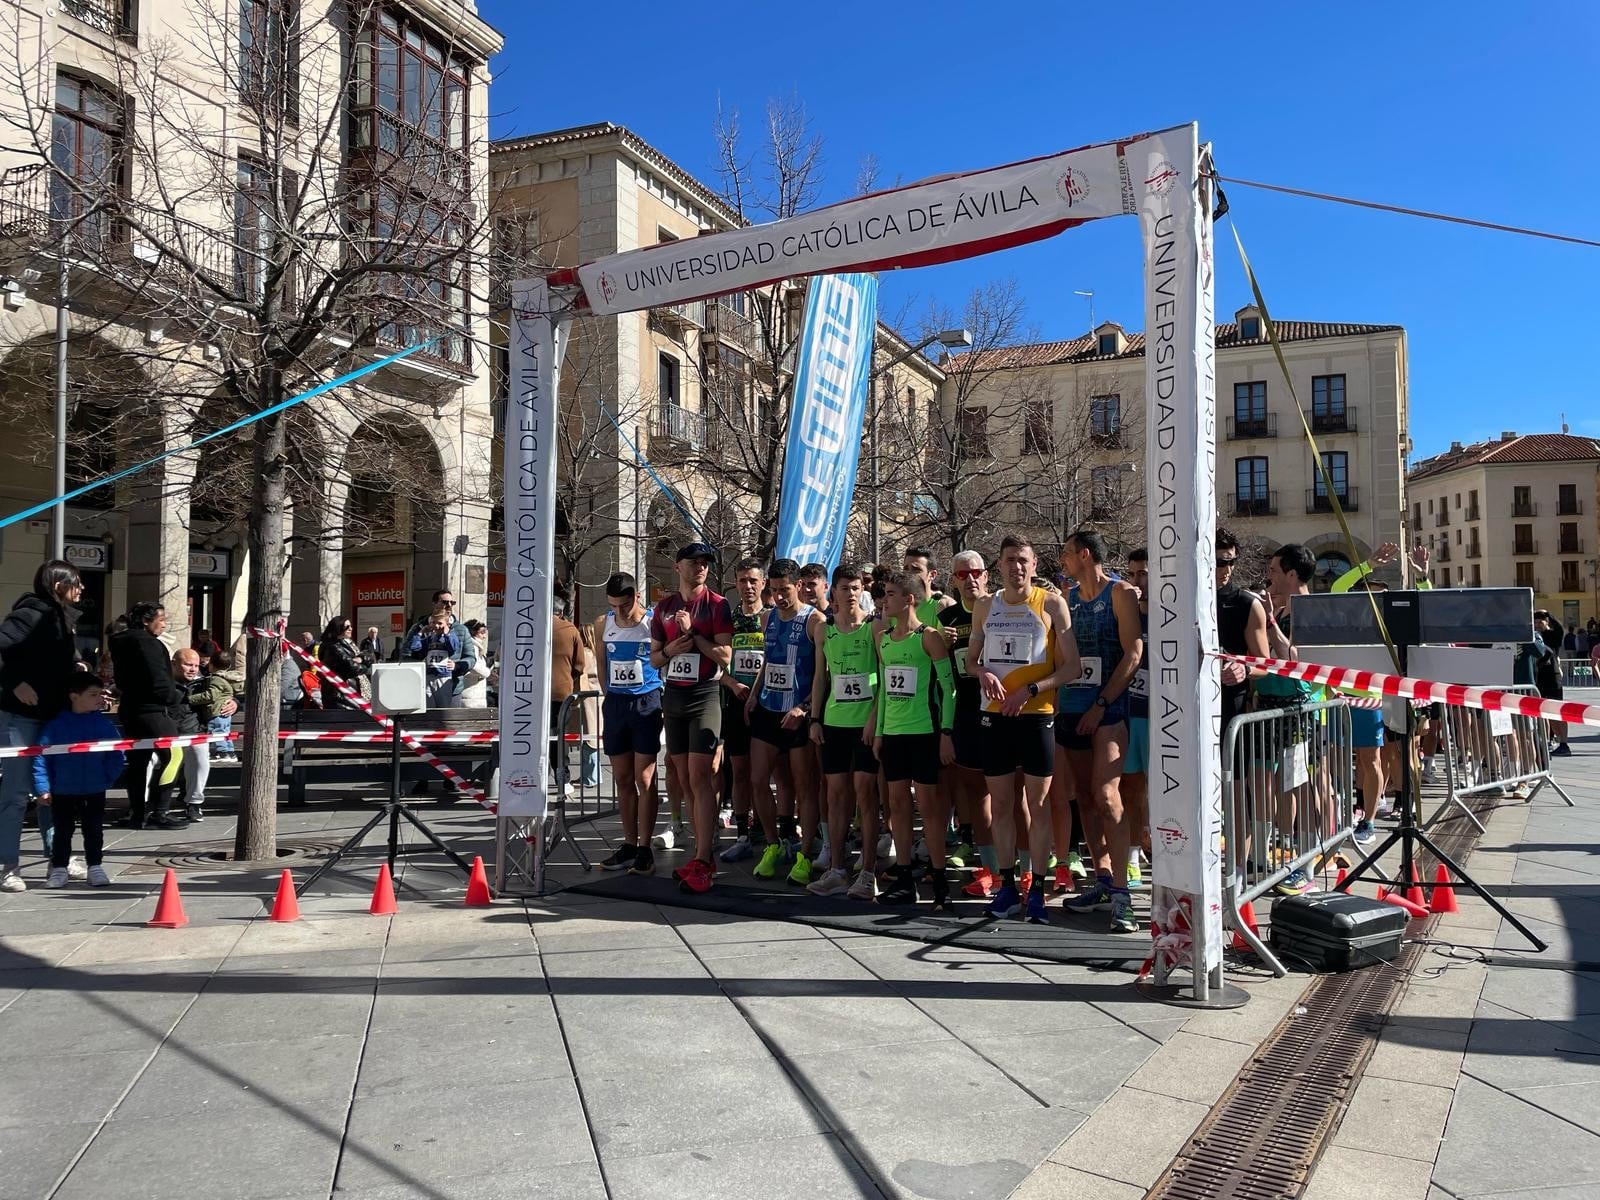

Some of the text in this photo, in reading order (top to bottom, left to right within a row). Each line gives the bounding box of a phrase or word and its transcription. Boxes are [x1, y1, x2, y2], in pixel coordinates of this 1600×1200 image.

[625, 242, 775, 292] UNIVERSIDAD
[781, 214, 901, 258] CATÓLICA
[907, 203, 945, 232] DE
[953, 185, 1039, 223] ÁVILA
[1154, 214, 1176, 450] UNIVERSIDAD
[516, 342, 540, 413] ÁVILA
[519, 419, 538, 452] DE
[514, 459, 537, 578] CATÓLICA
[1158, 461, 1182, 628] CATÓLICA
[357, 589, 405, 601] bankinter
[739, 658, 761, 670] 108
[1004, 642, 1012, 656] 1
[1160, 640, 1179, 685] DE
[513, 585, 535, 756] UNIVERSIDAD
[614, 669, 636, 681] 166
[672, 662, 692, 674] 168
[769, 672, 787, 685] 125
[890, 675, 905, 689] 32
[844, 683, 862, 696] 45
[1161, 695, 1184, 795] ÁVILA
